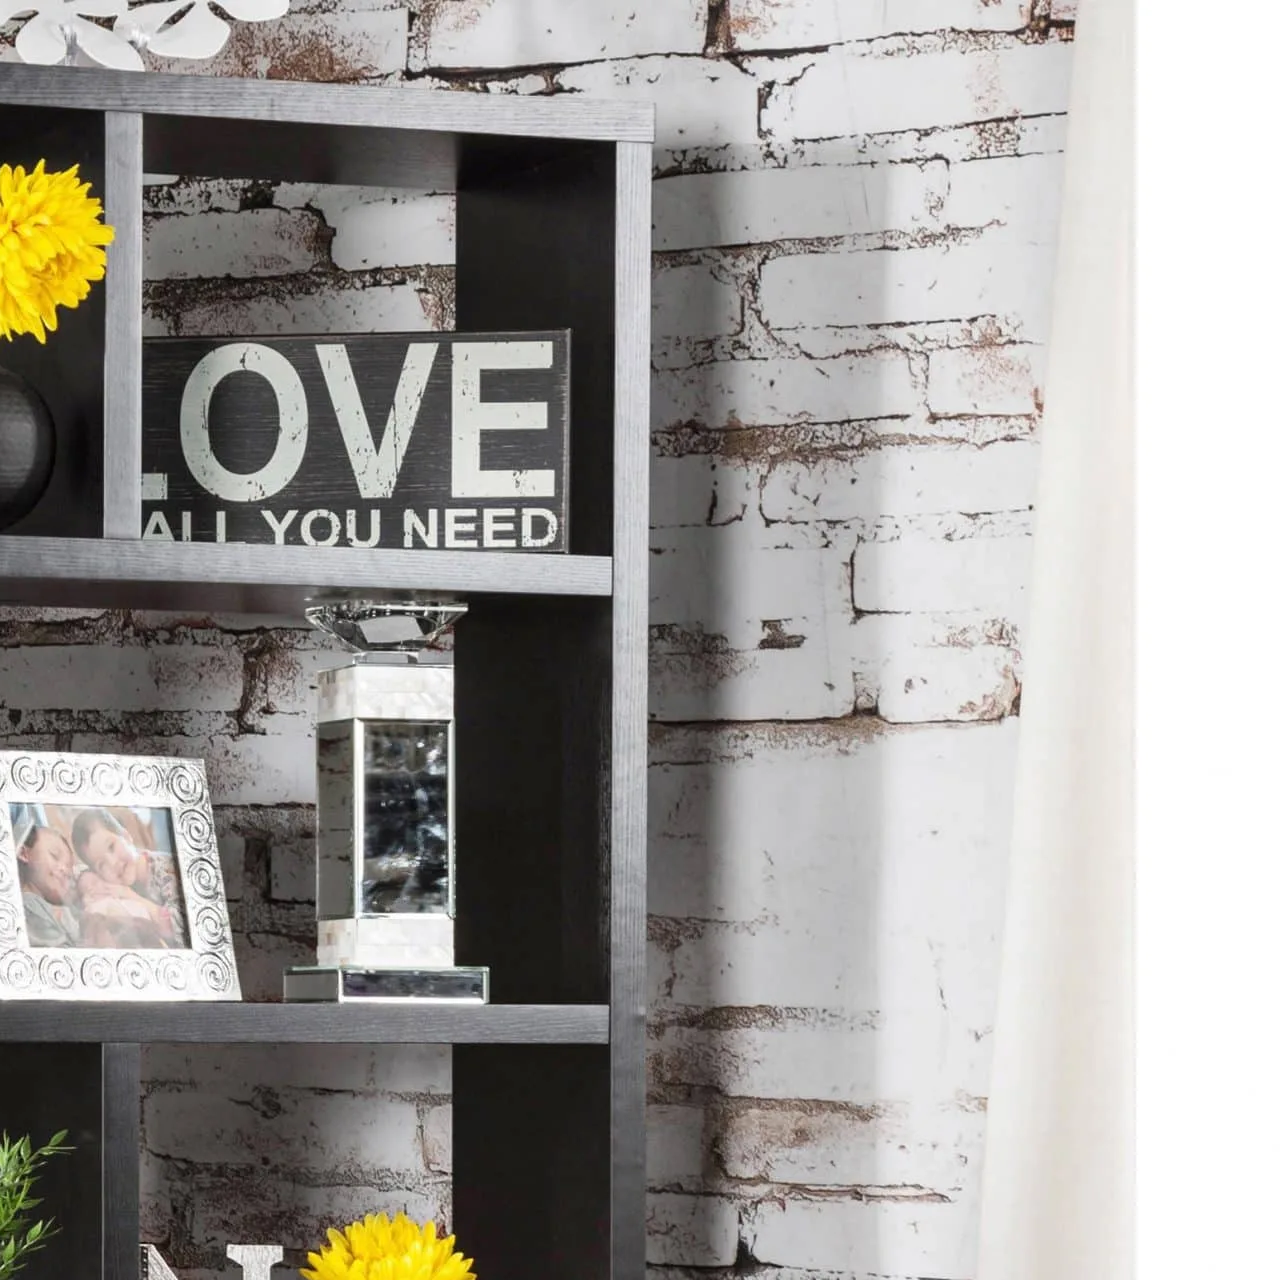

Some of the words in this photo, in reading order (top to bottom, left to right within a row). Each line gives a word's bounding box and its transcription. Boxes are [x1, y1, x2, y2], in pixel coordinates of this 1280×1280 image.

[141, 511, 246, 543] ALL
[261, 508, 381, 548] YOU
[403, 507, 558, 548] NEED
